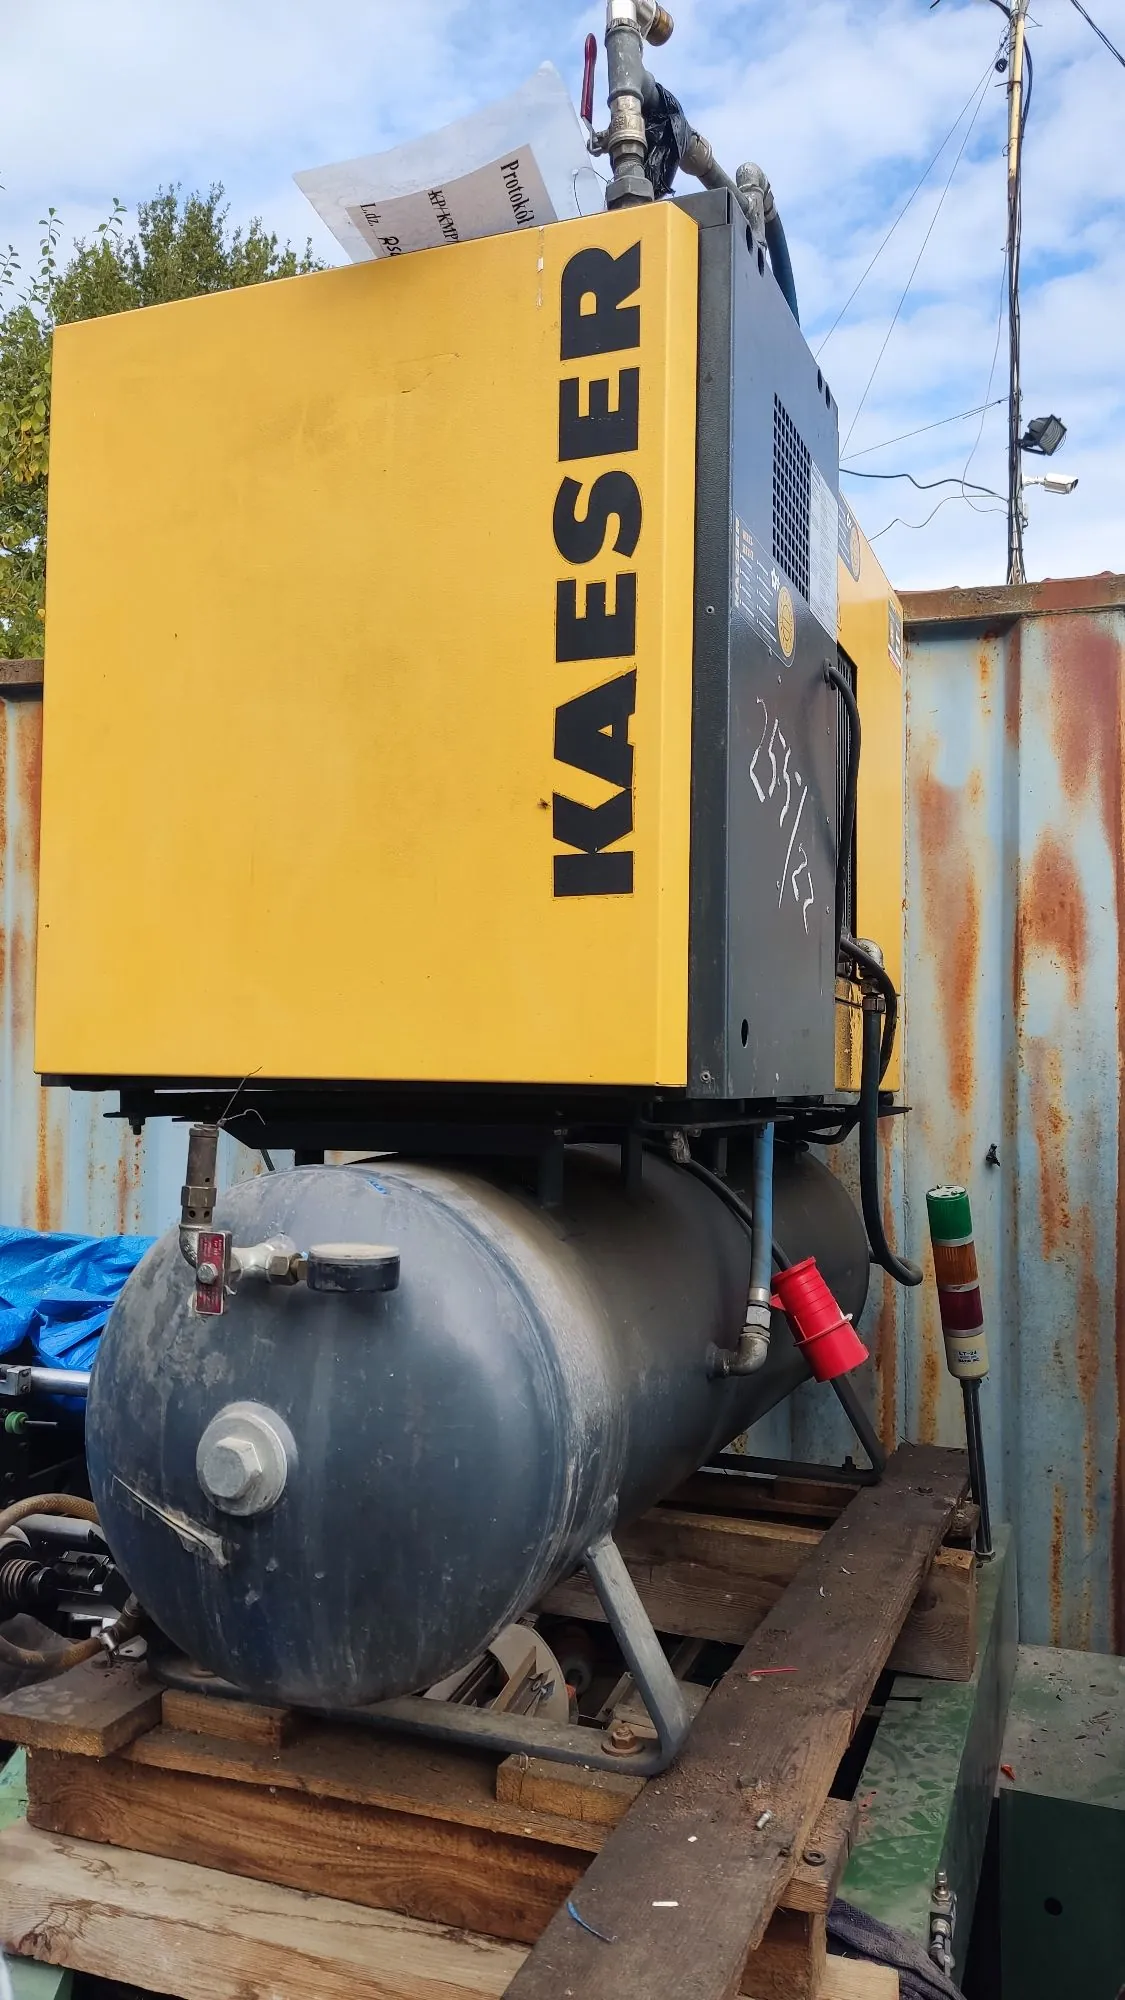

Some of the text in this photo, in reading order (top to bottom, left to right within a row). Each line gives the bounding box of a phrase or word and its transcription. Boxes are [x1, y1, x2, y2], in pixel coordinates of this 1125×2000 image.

[359, 202, 381, 227] L.dz.
[500, 159, 535, 226] Protokół
[552, 240, 643, 898] KAESER
